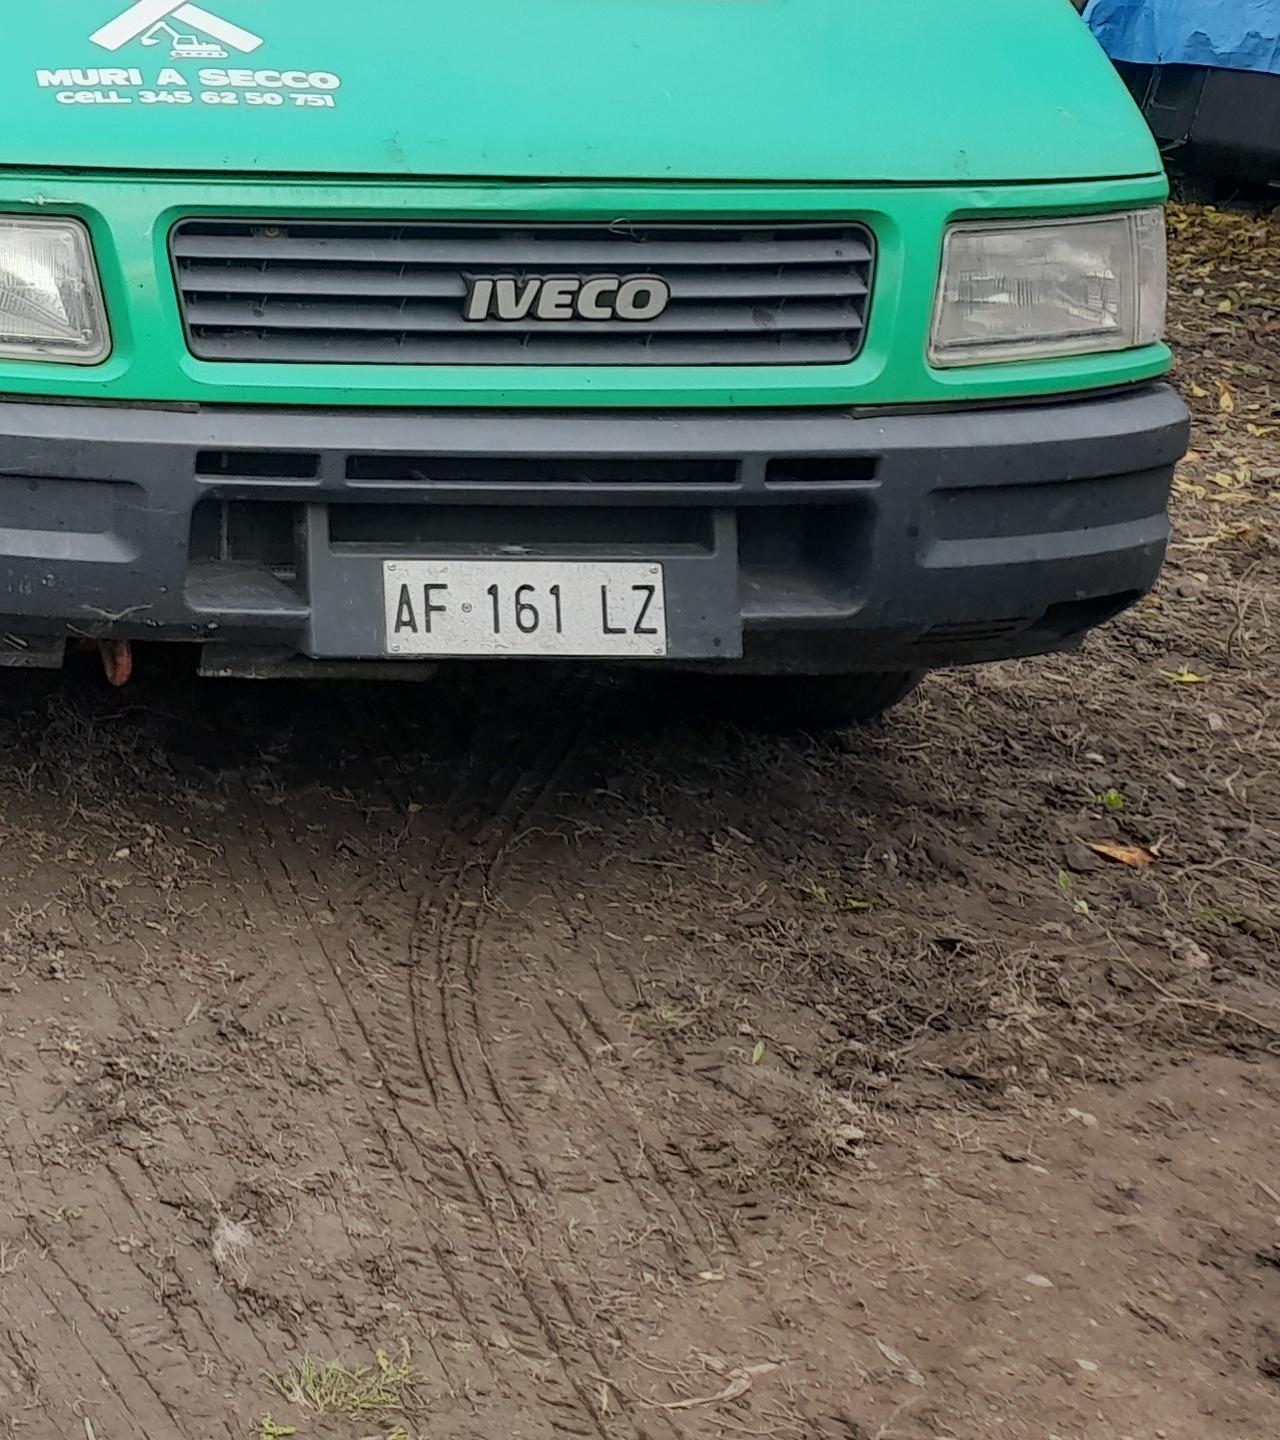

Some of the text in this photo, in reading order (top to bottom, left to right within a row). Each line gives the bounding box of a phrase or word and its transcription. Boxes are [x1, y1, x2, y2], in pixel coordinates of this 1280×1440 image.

[36, 68, 342, 90] MURI A SECCO
[138, 90, 194, 104] 345
[200, 91, 239, 105] 62
[244, 91, 284, 106] 50
[289, 93, 337, 107] 751
[465, 276, 670, 321] IVECO
[394, 583, 658, 634] AF 161 LZ
